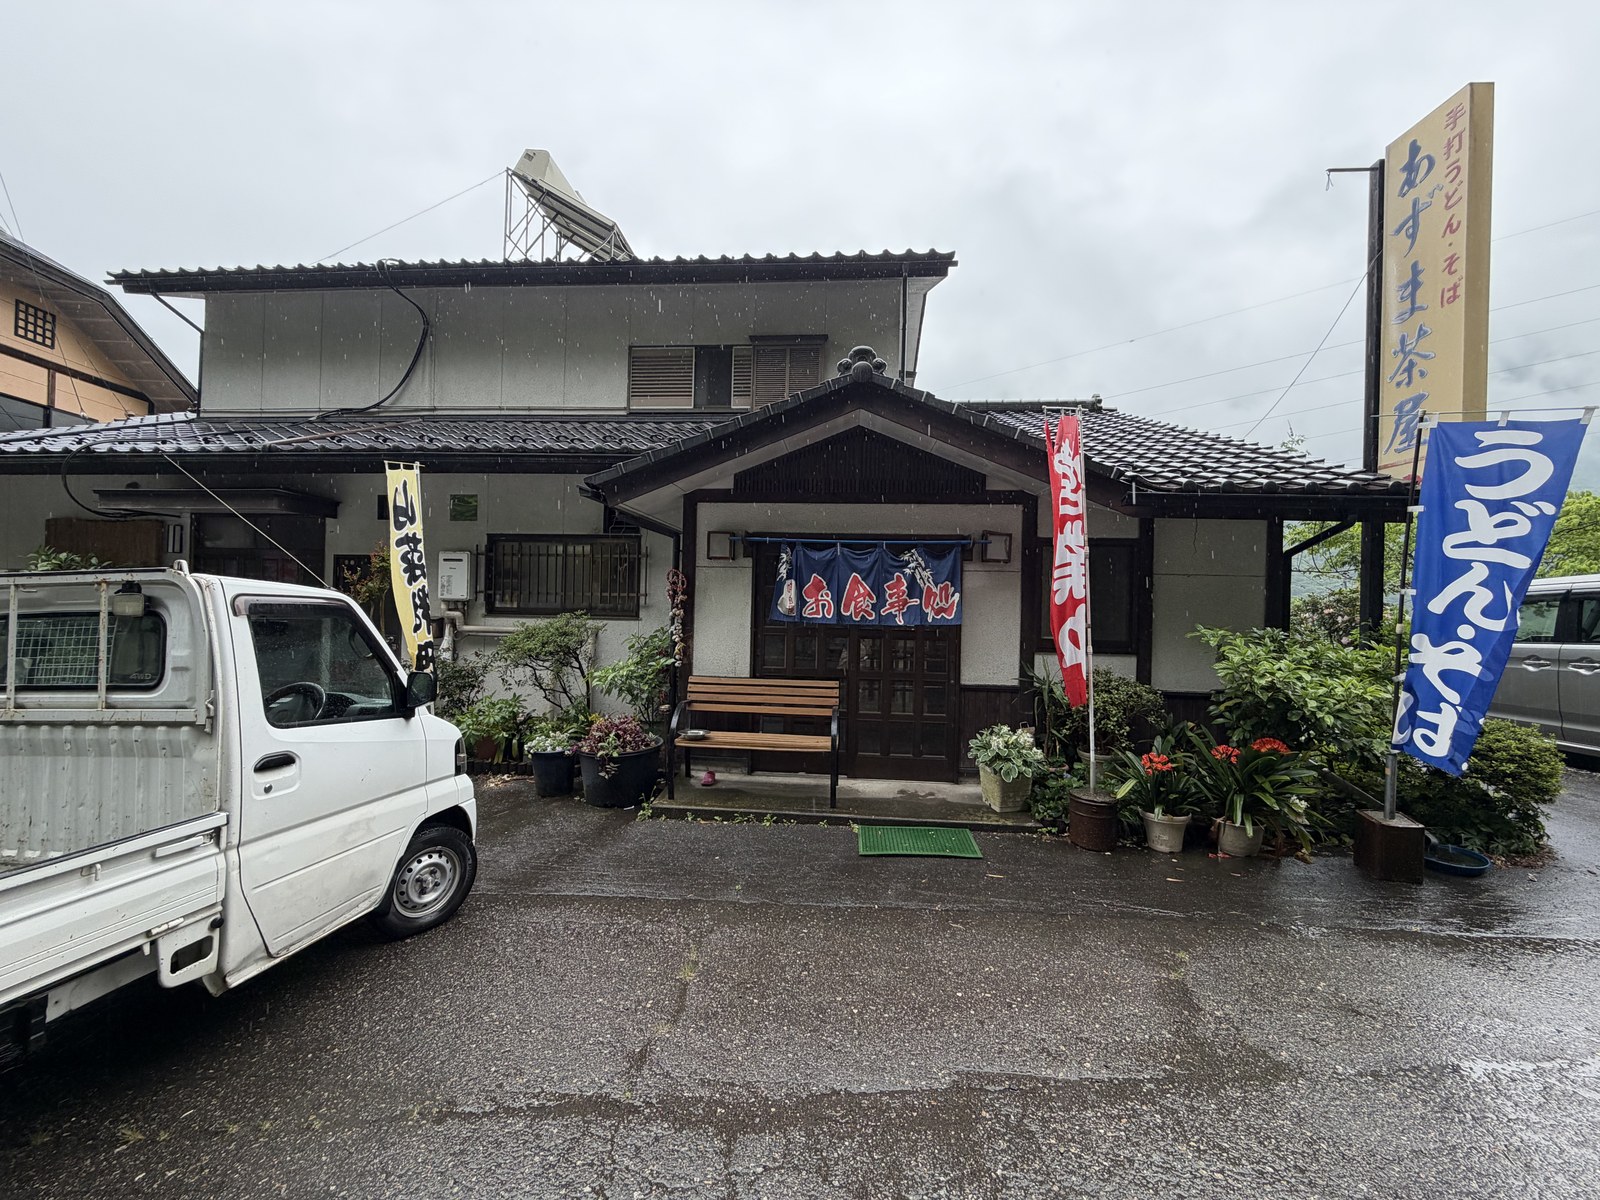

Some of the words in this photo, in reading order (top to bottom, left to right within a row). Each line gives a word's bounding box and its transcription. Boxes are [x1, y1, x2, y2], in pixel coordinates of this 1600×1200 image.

[1383, 138, 1443, 456] あずま茶屋
[1440, 102, 1466, 308] 手打うどん・そば
[129, 672, 152, 680] 4WD
[802, 572, 960, 625] お食事処
[1393, 430, 1557, 768] うどん・そば
